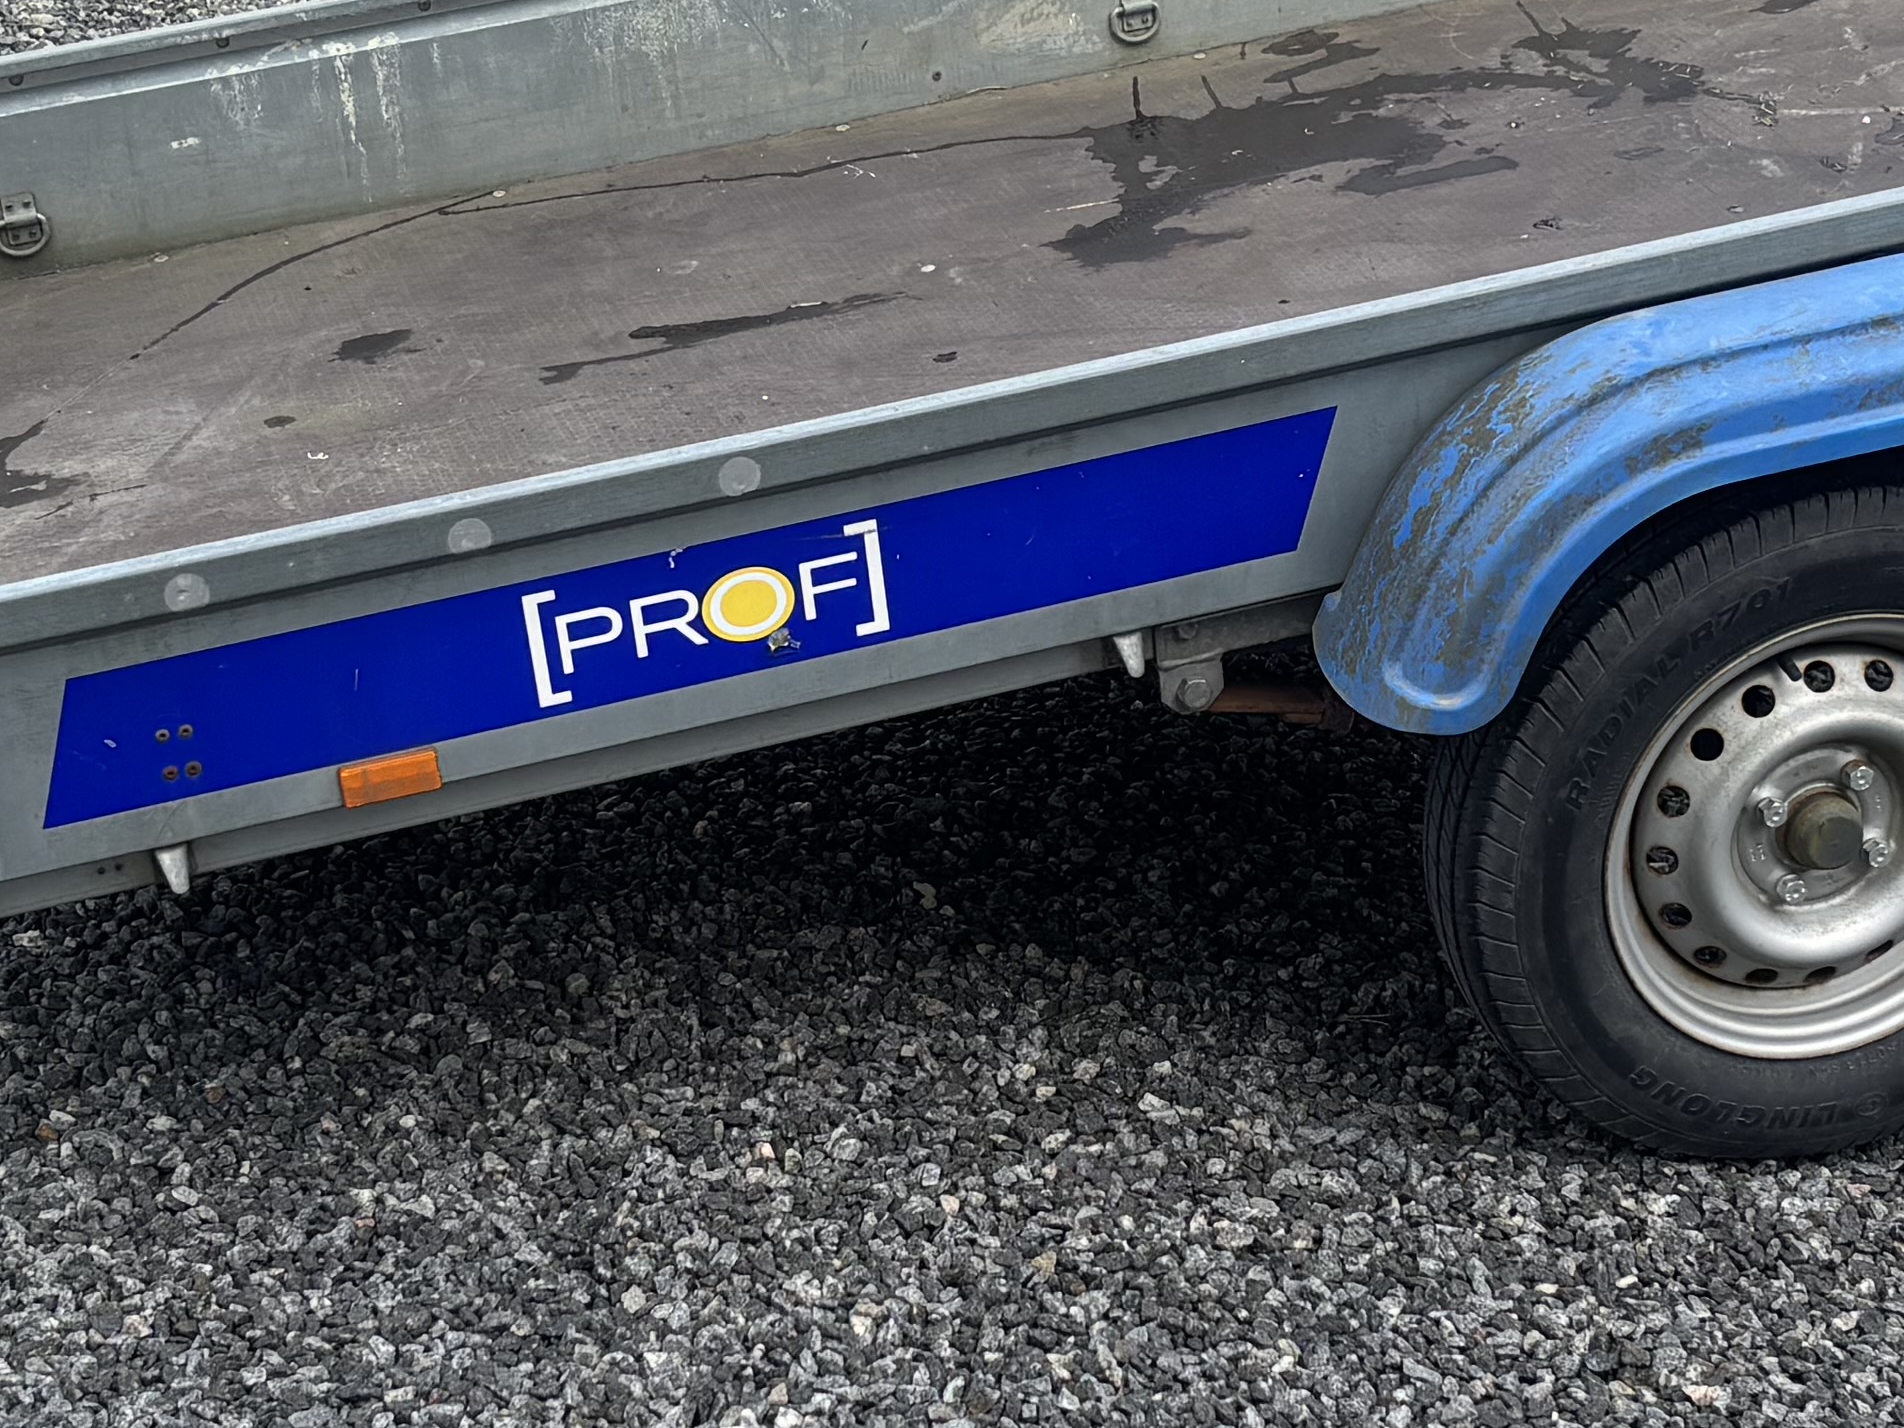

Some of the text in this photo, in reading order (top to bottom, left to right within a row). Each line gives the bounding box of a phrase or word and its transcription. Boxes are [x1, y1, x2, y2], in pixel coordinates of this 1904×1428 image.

[1565, 576, 1791, 812] RADIAL R701
[1627, 1064, 1839, 1130] LINGLONG
